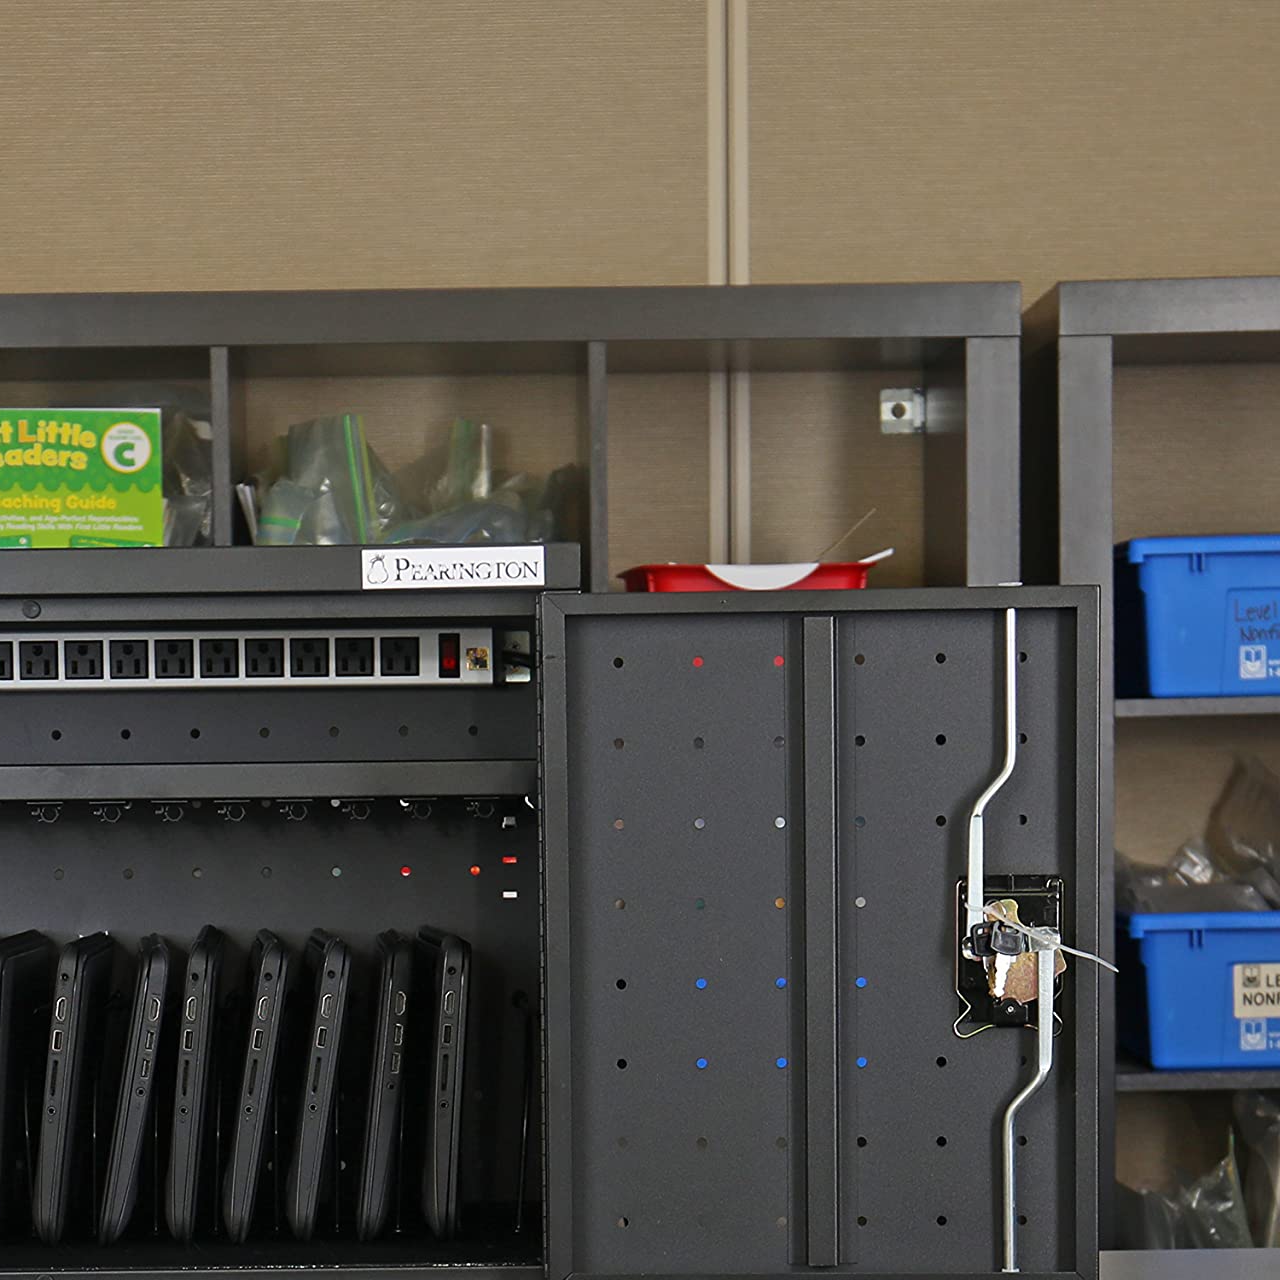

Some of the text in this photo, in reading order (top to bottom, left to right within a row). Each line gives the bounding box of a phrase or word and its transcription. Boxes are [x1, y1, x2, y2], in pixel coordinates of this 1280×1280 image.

[18, 419, 97, 449] Little
[114, 441, 136, 467] C
[66, 494, 118, 510] Guide
[394, 557, 540, 582] PEARINGTON
[1233, 599, 1278, 622] Level
[1241, 623, 1280, 641] Nonf
